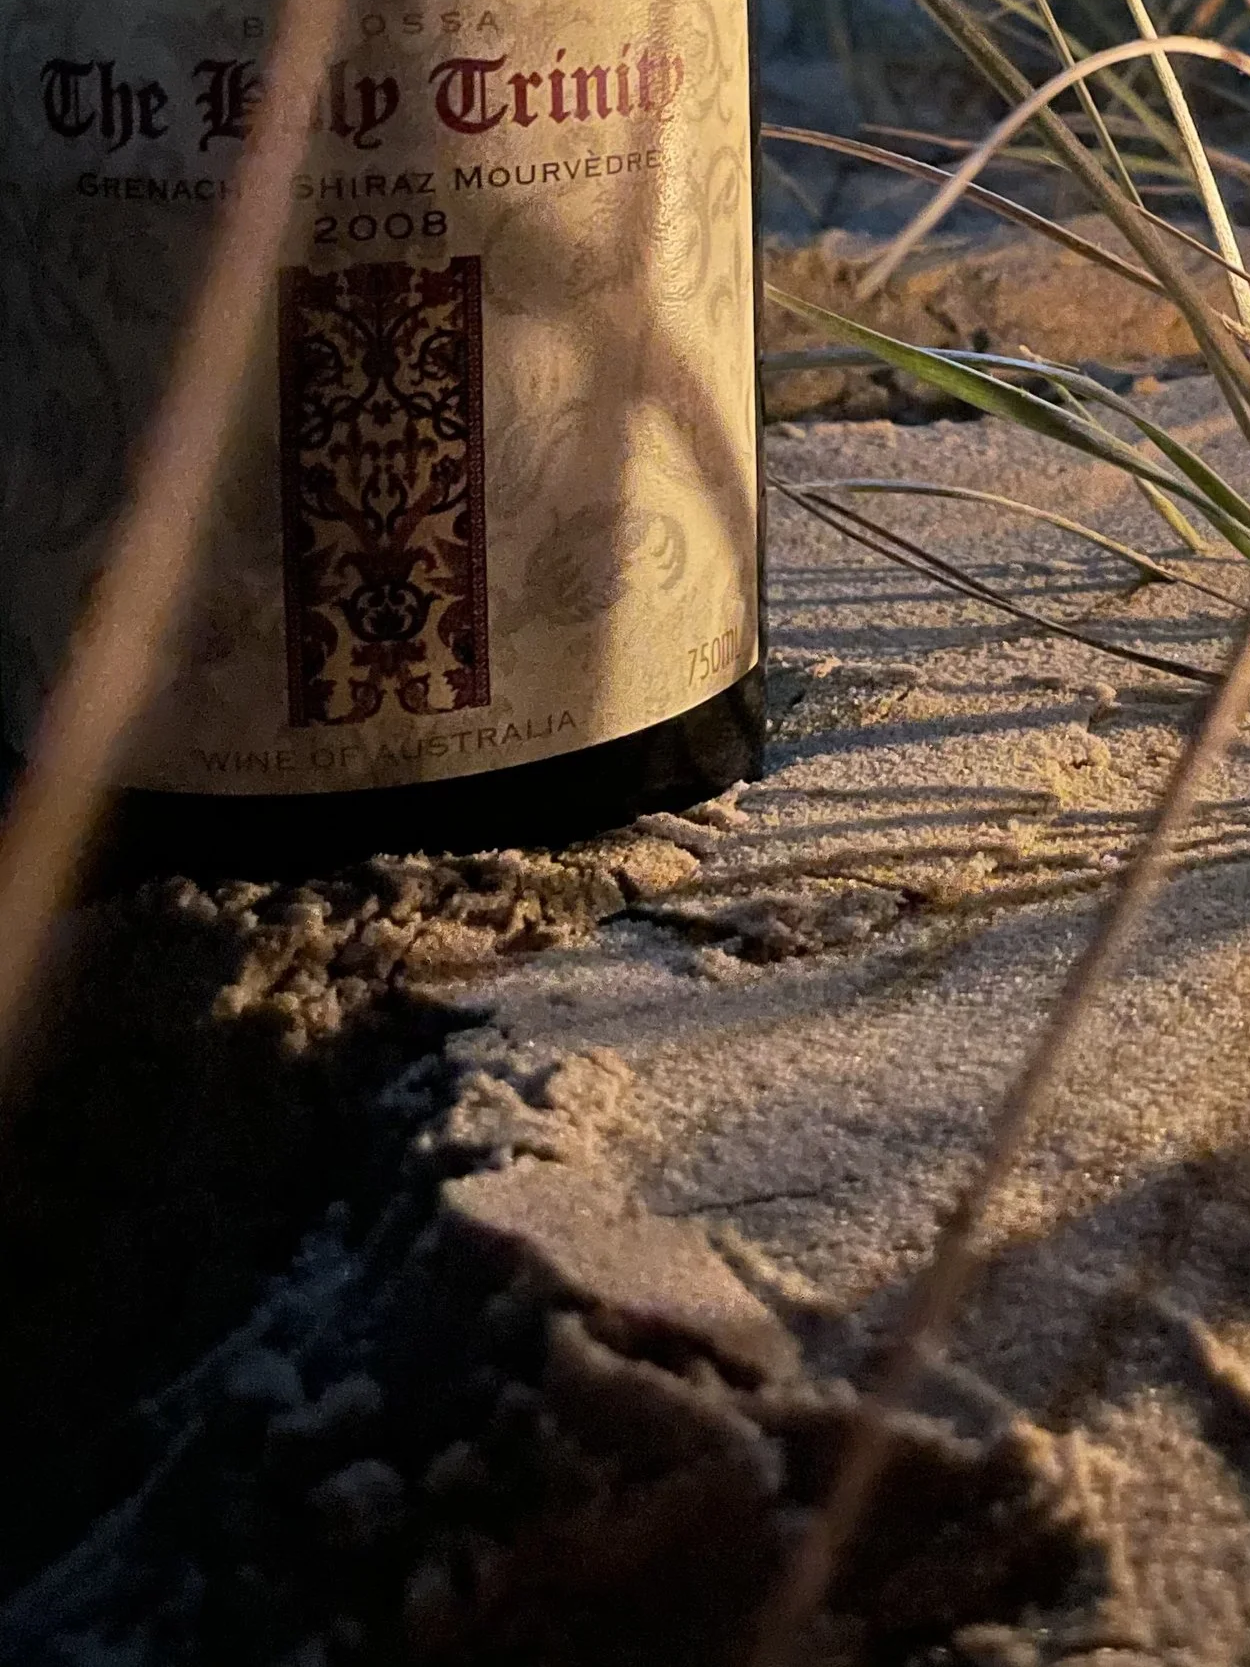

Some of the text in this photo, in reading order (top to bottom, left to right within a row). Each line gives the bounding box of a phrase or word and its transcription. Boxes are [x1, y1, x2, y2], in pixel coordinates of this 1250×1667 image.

[243, 10, 500, 39] BOSSA
[39, 43, 685, 154] The Hly Trinity
[78, 149, 663, 201] GRENACH SHIRAZ MOURVÈDRE
[312, 210, 449, 245] 2008
[202, 709, 580, 774] WINE OF AUSTRALIA
